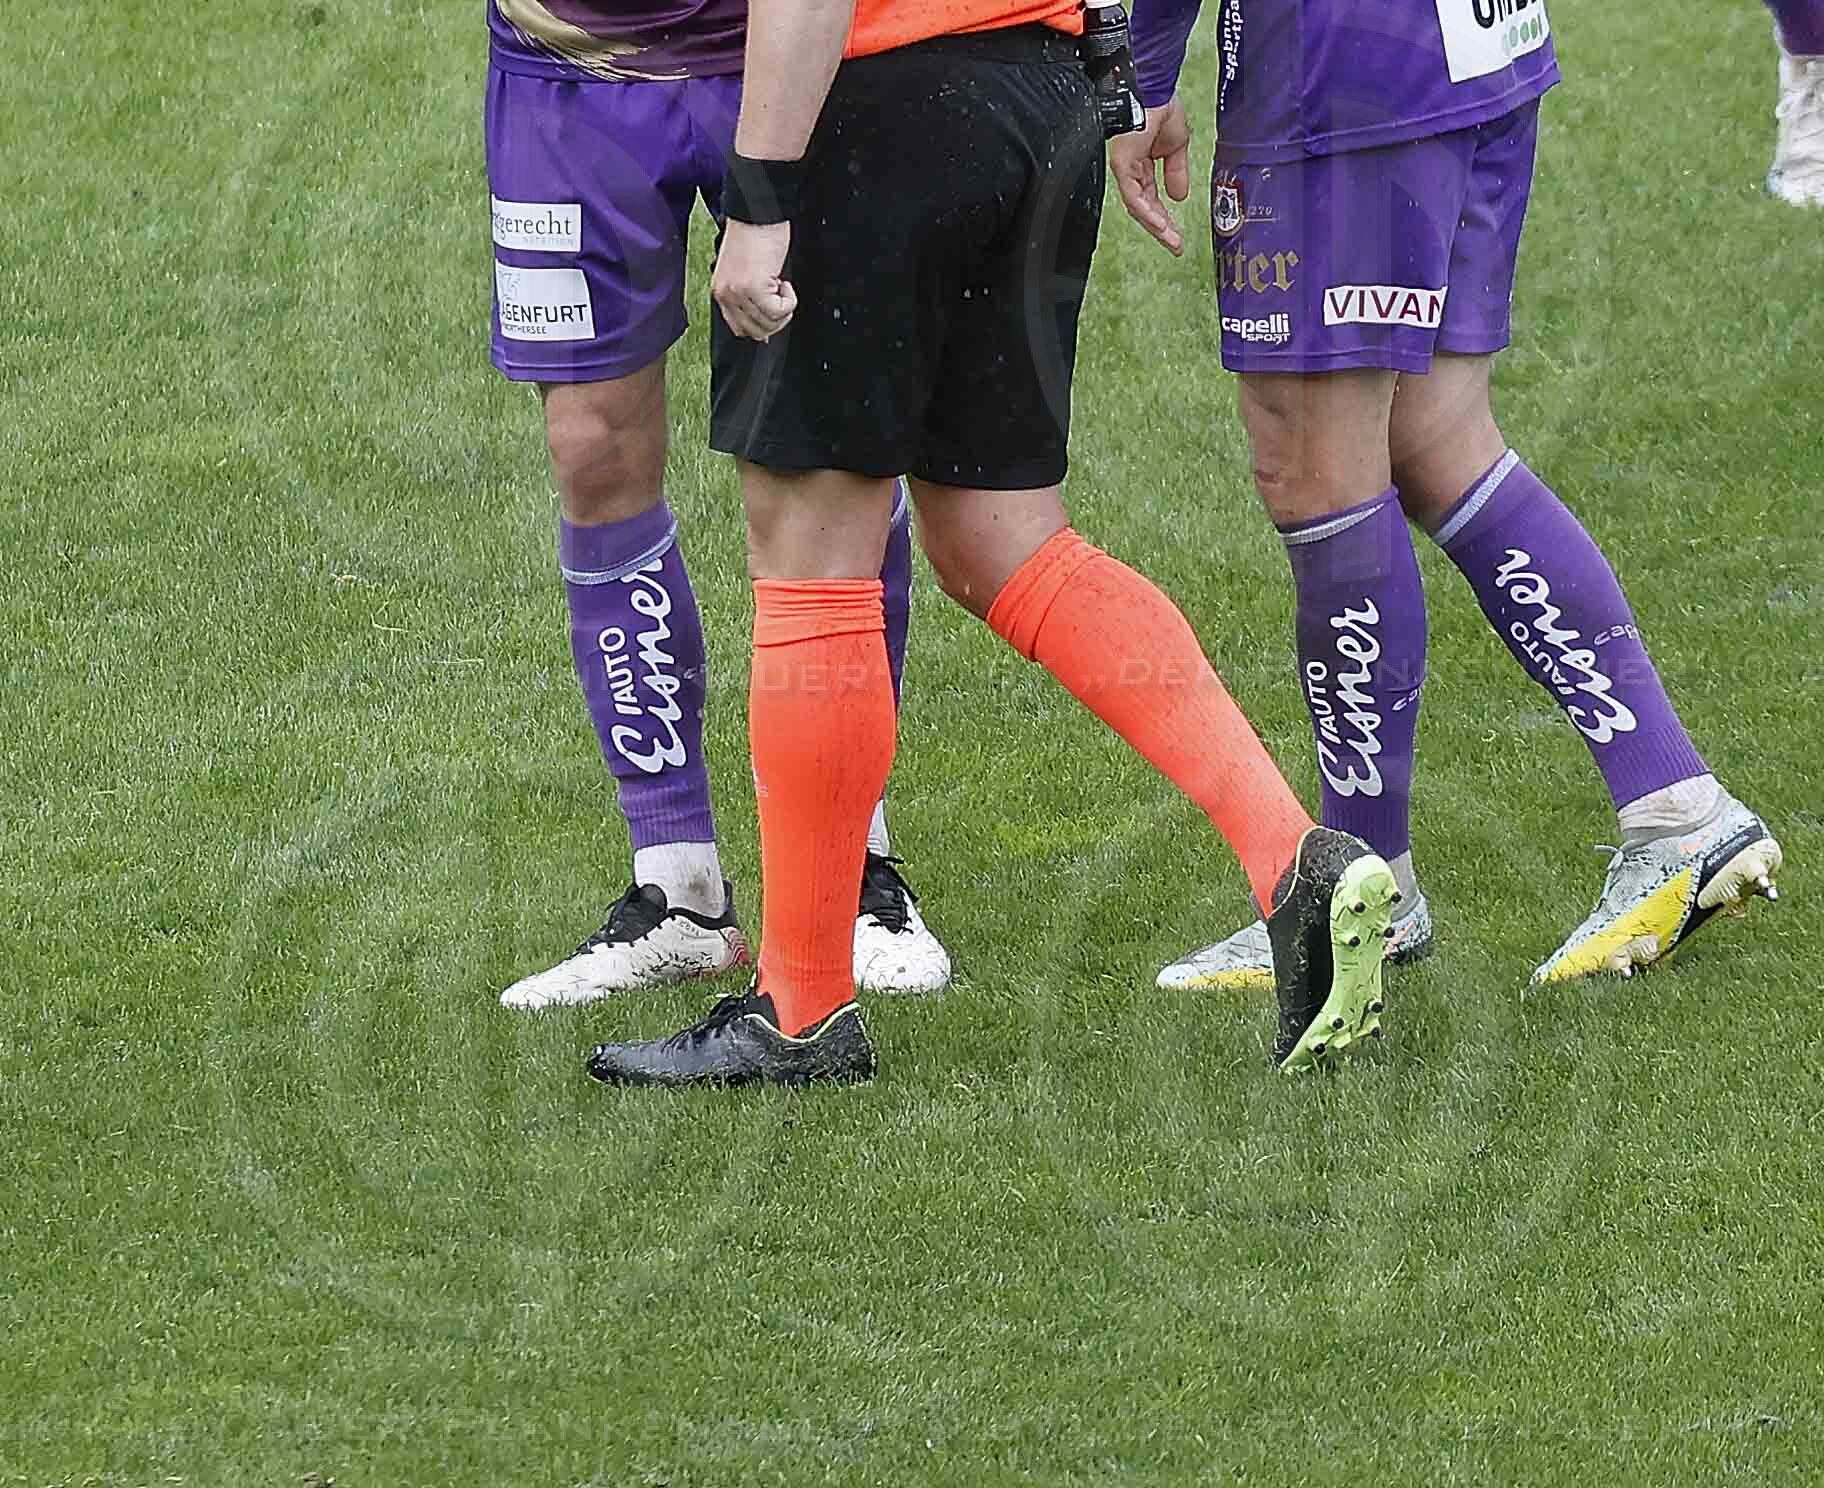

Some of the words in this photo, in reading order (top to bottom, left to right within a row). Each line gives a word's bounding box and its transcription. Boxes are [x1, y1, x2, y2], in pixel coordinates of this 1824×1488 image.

[1222, 313, 1290, 341] capelli
[599, 626, 639, 715] AUTO
[612, 558, 687, 774] Eisner
[1495, 548, 1639, 744] Eisner
[1510, 620, 1576, 696] AUTO
[1306, 661, 1341, 744] AUTO
[1316, 597, 1383, 797] Eisner
